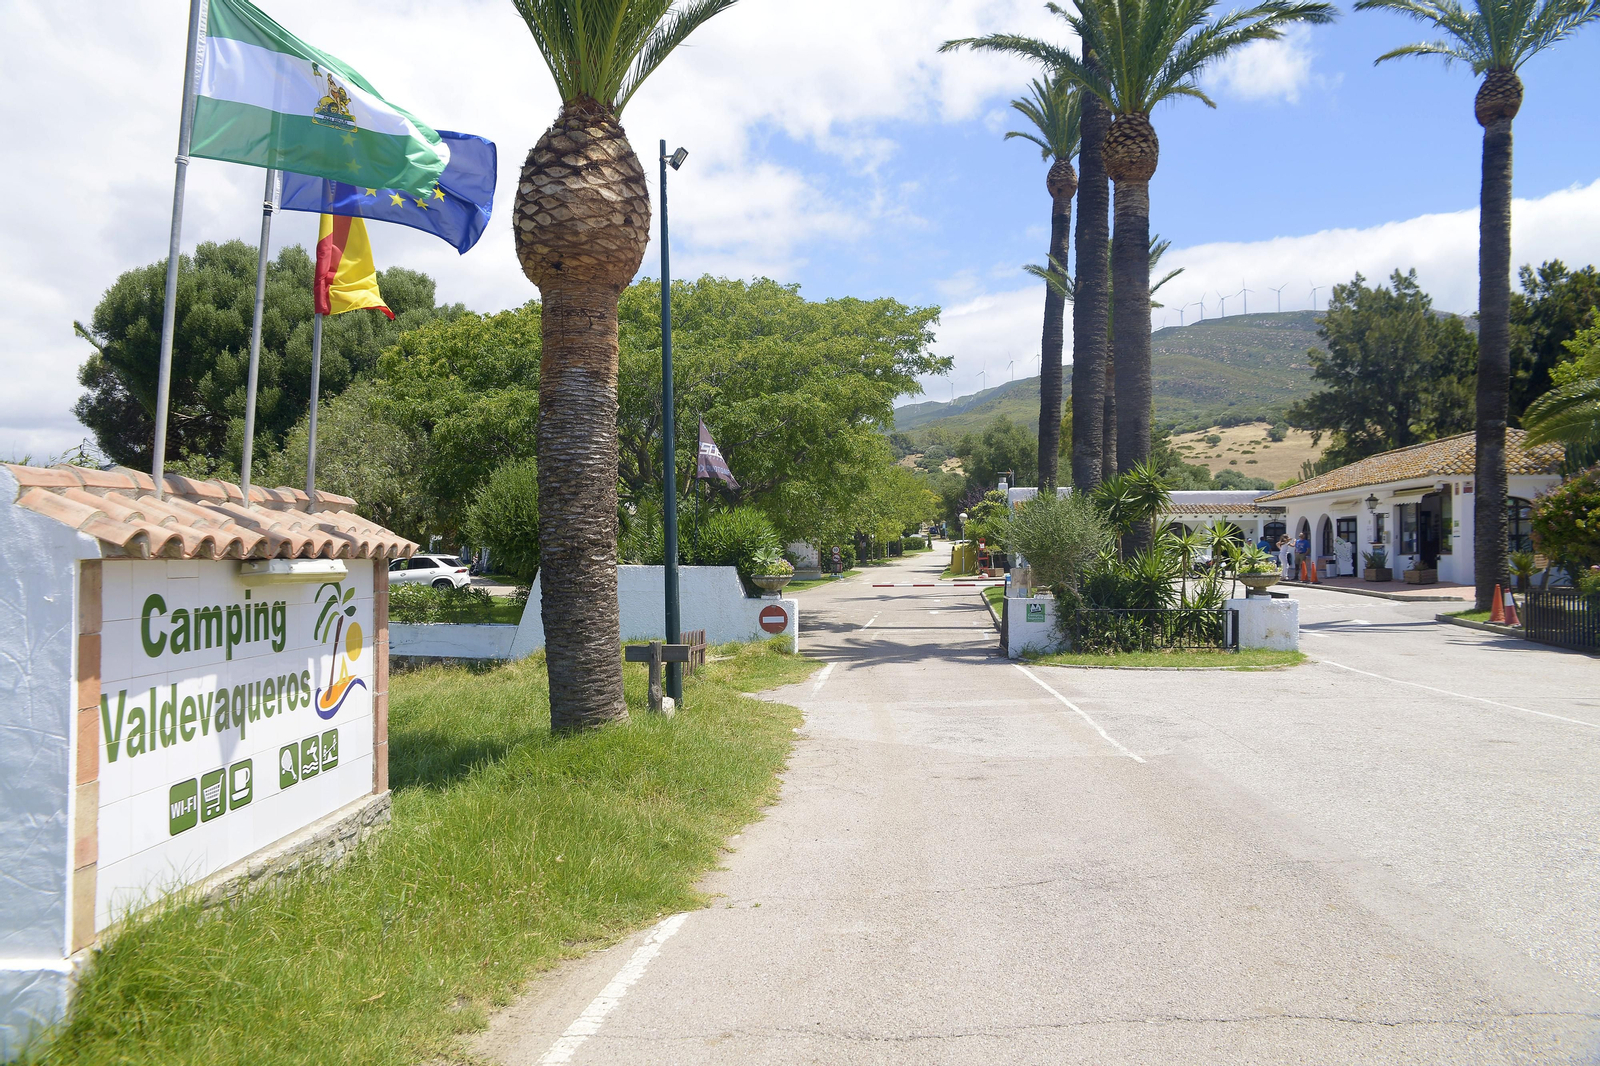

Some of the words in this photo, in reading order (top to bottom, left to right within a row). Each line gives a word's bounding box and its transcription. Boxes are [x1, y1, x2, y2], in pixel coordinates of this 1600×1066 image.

[141, 590, 286, 660] Camping
[100, 669, 311, 764] Valdevaqueros
[170, 794, 197, 819] WI-FI
